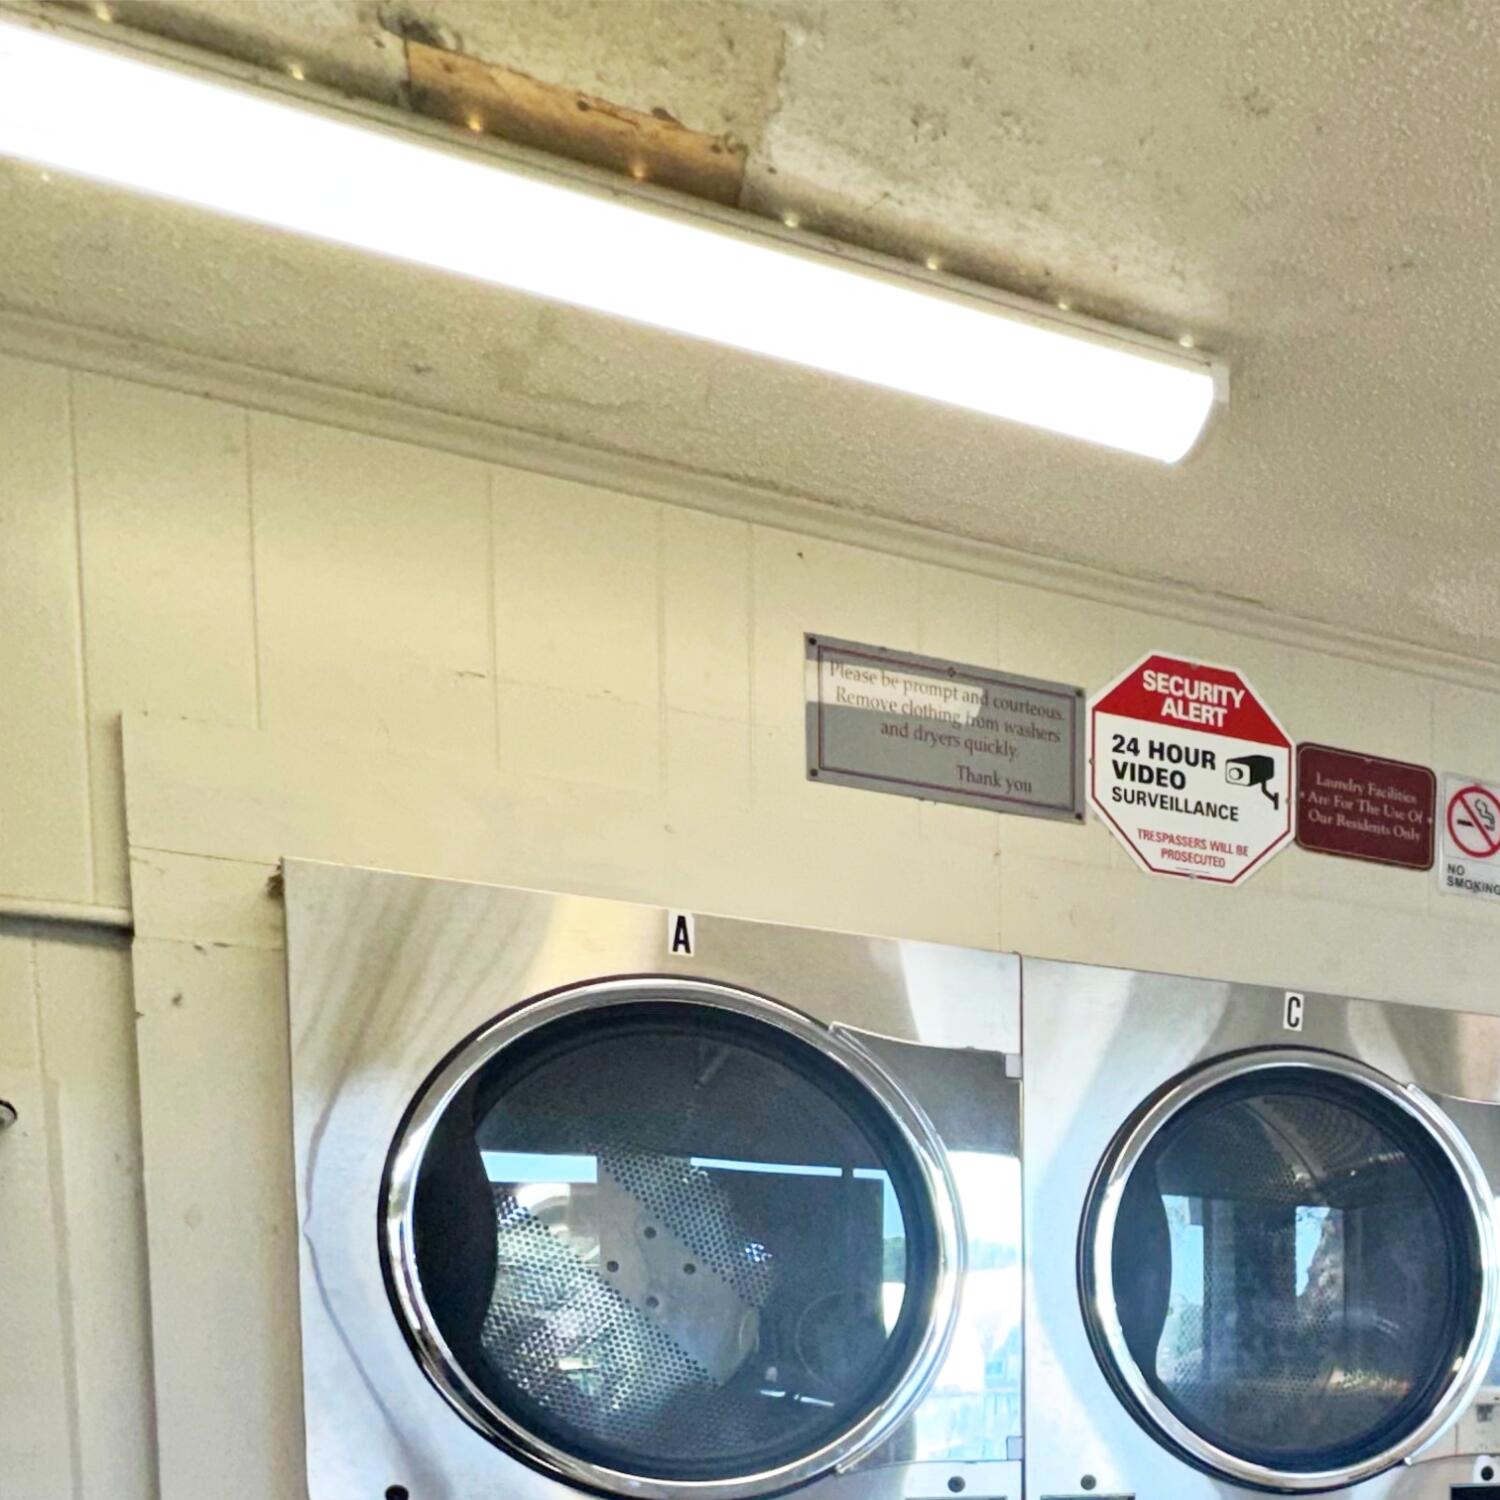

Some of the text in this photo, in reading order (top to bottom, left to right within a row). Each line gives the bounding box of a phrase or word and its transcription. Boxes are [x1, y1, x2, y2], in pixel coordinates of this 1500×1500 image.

[829, 660, 877, 686] Please
[881, 671, 900, 689] be
[903, 678, 959, 701] prompt
[962, 686, 989, 707] and
[1142, 669, 1246, 709] SECURITY
[836, 686, 1061, 743] Remove clothing from washers
[1160, 697, 1228, 728] ALERT
[881, 720, 1019, 759] and dryers quickly.
[1111, 733, 1217, 771] 24 HOUR
[956, 763, 1032, 794] Thank you
[1111, 759, 1187, 791] VIDEO
[1316, 771, 1417, 804] Laundry Facilities
[1111, 786, 1240, 822] SURVEILLANCE
[1308, 791, 1424, 824] Are For The Use Of
[1308, 808, 1421, 841] Our Residents Only
[1136, 827, 1249, 857] TRESPASSERS WILL BE
[1160, 848, 1227, 869] PROSECUTED
[1447, 863, 1466, 876] NO
[672, 915, 691, 954] A
[1287, 996, 1301, 1028] C
